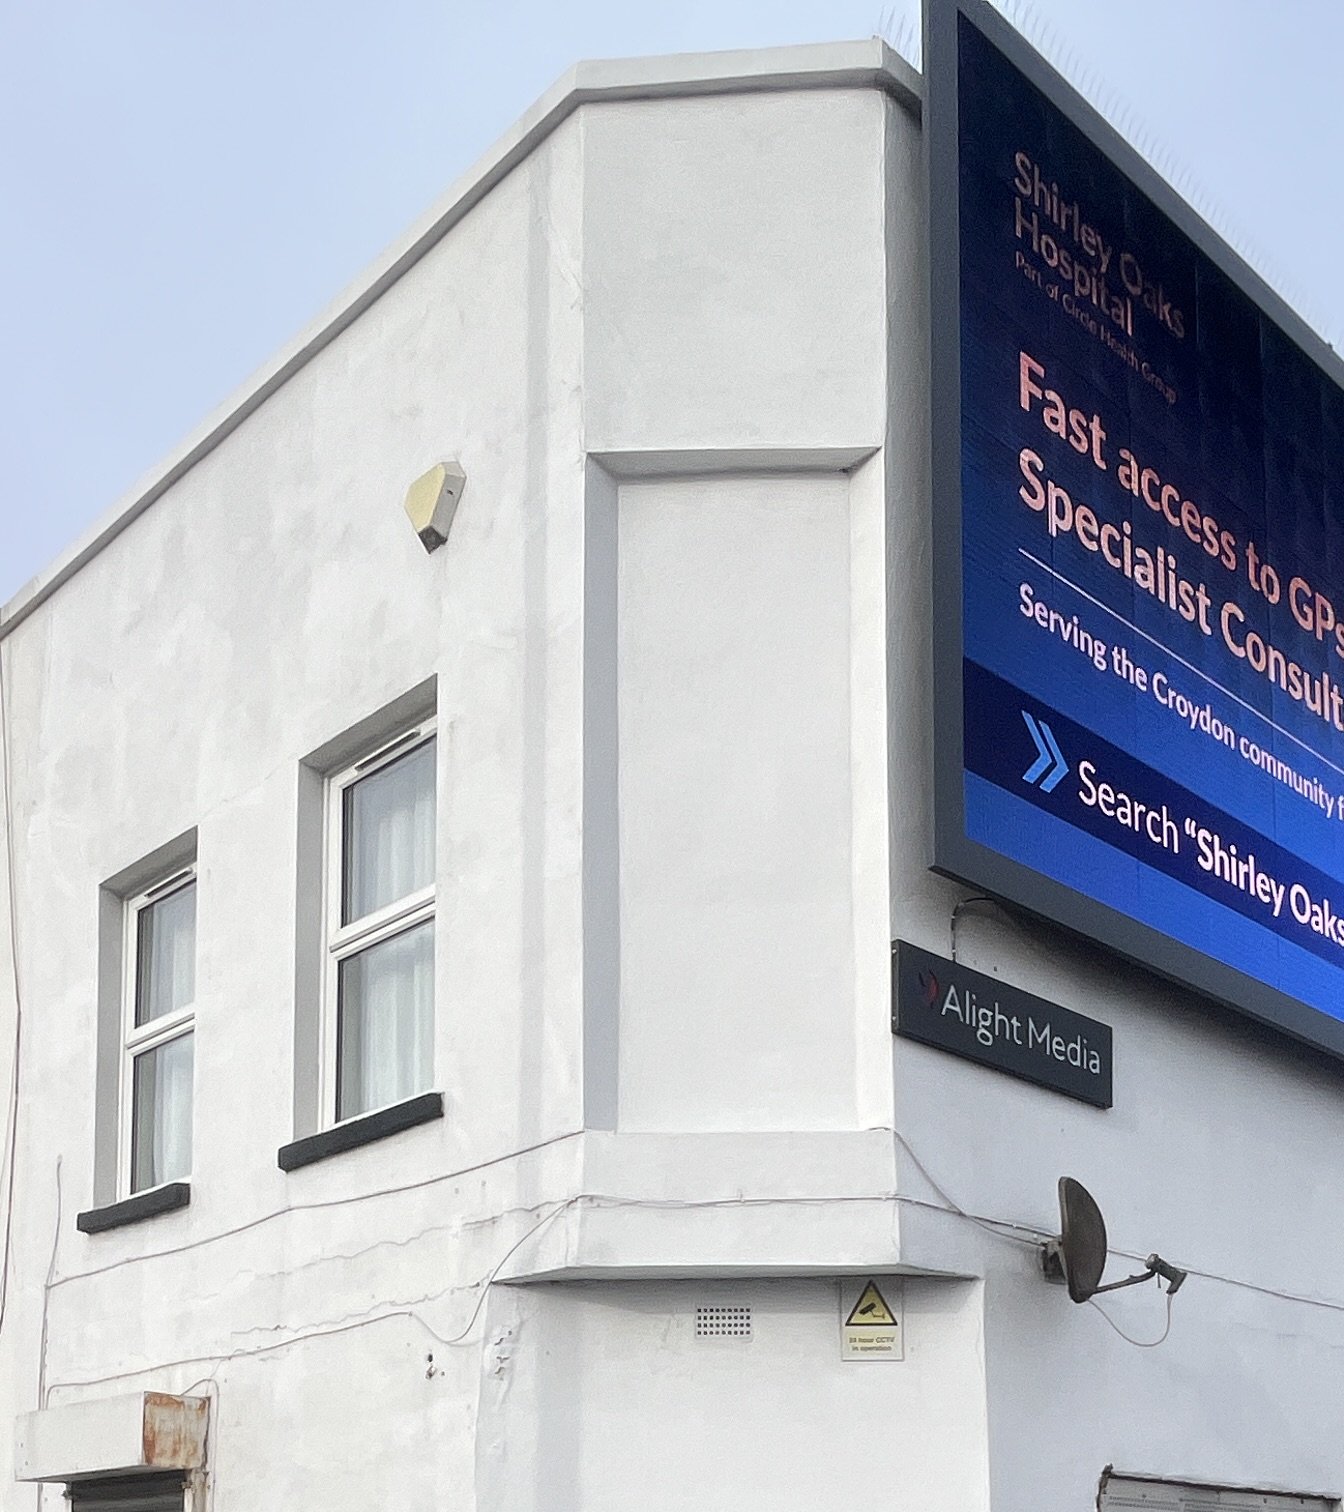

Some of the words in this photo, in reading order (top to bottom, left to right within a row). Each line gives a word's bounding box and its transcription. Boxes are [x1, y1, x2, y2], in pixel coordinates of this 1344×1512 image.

[1014, 151, 1113, 273] Shirley
[1120, 252, 1185, 338] Oaks
[1014, 196, 1133, 337] Hospital
[1016, 250, 1042, 288] Part
[1018, 447, 1213, 636] Specialist
[1019, 350, 1107, 470] Fast
[1117, 447, 1237, 571] access
[1245, 540, 1281, 605] to
[1019, 582, 1107, 671] Serving
[1111, 644, 1149, 692] the
[1152, 671, 1236, 750] Croydon
[1239, 735, 1334, 819] community
[1078, 760, 1180, 854] Search
[940, 983, 1023, 1046] Alight
[1027, 1016, 1101, 1075] Media
